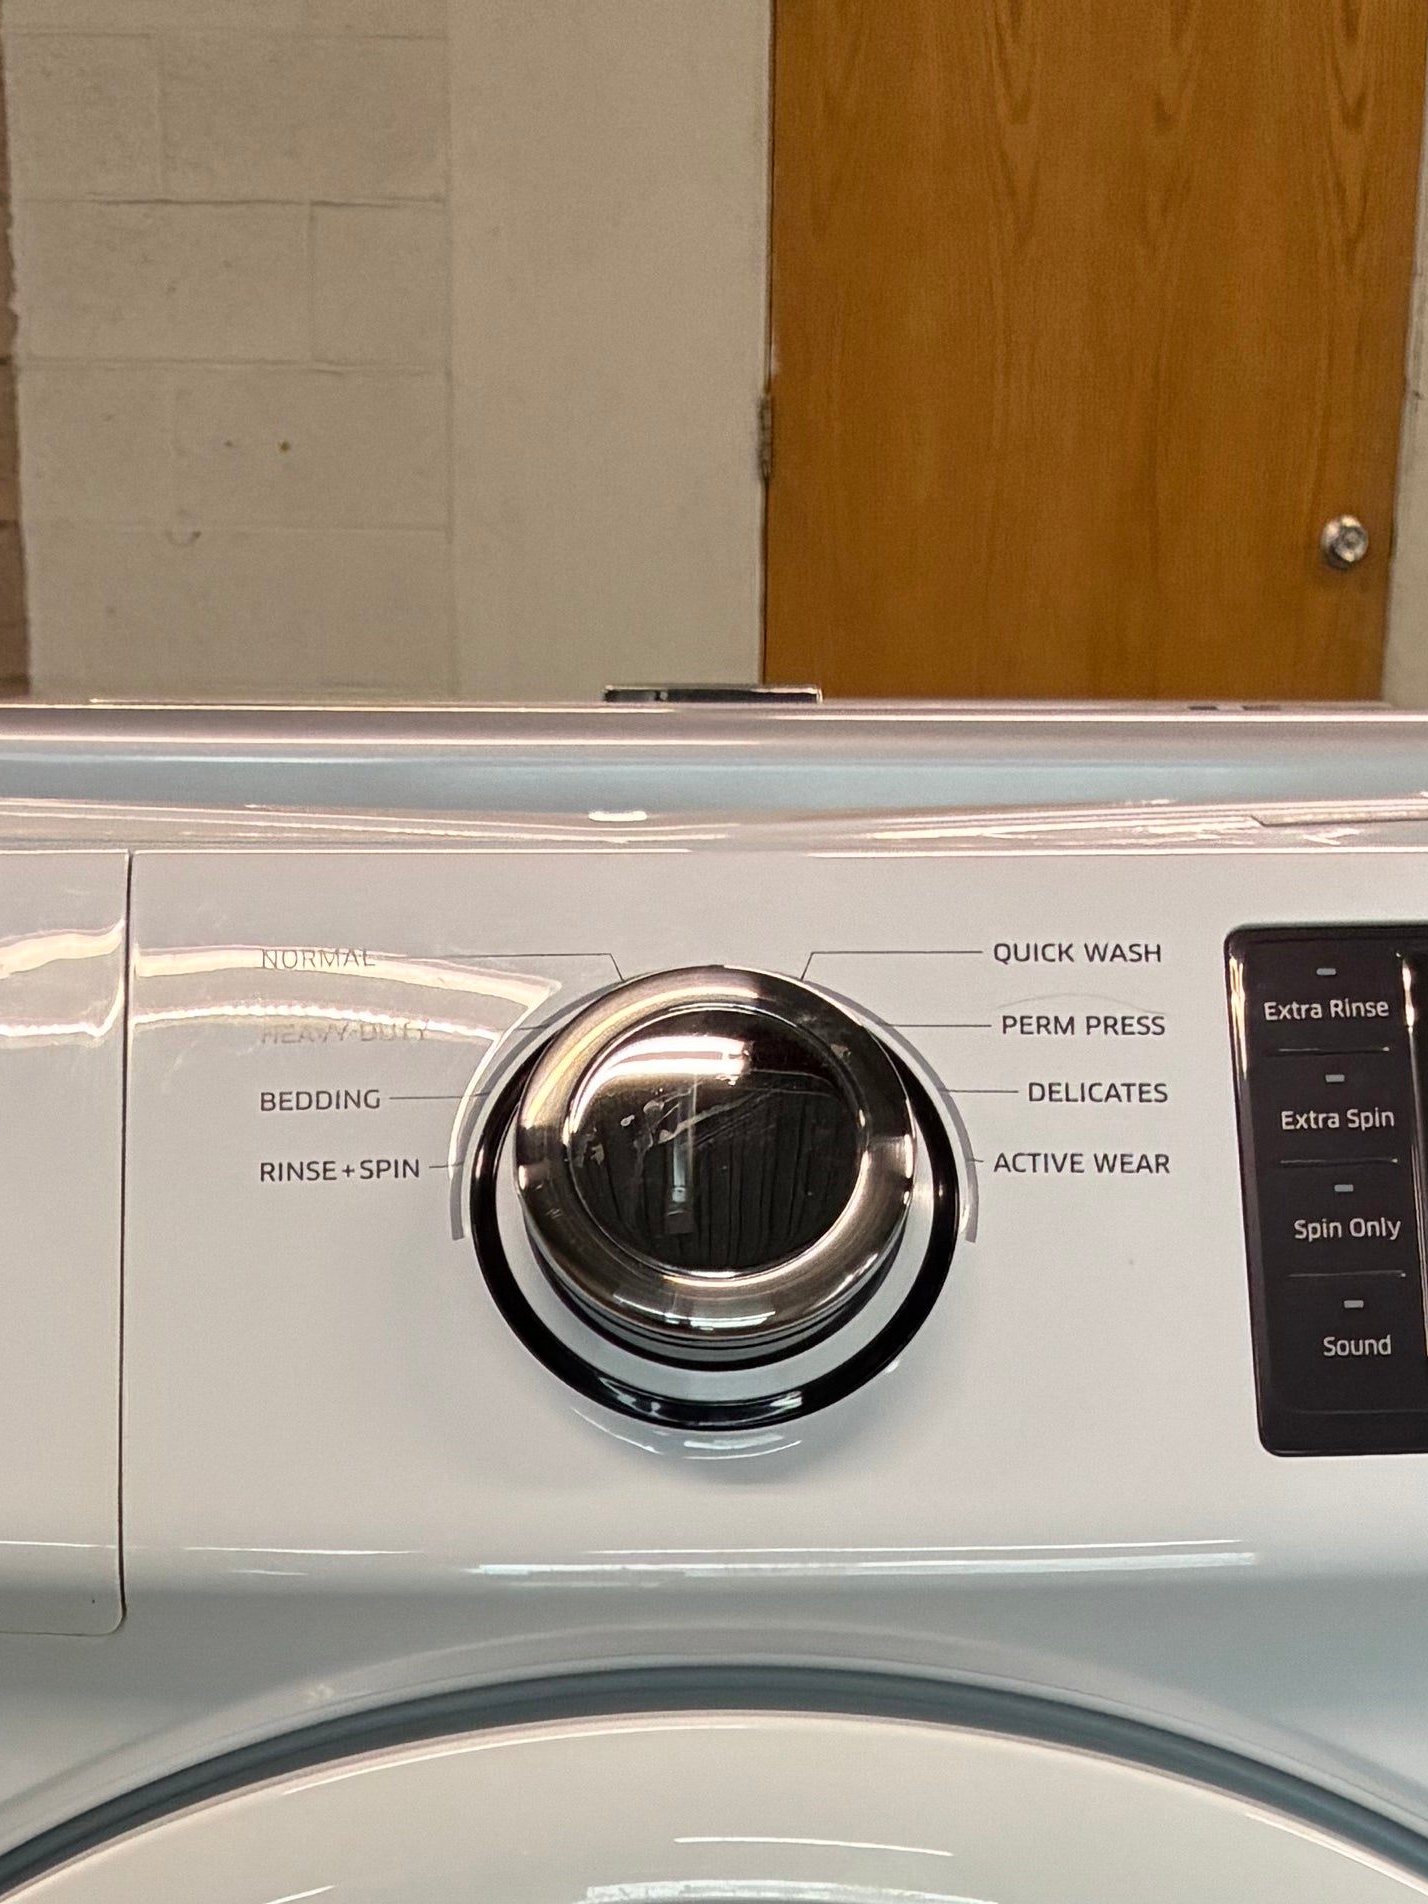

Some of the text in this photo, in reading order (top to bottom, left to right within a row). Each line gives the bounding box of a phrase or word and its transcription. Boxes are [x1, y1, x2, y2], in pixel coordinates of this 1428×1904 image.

[261, 948, 376, 969] NORMAL
[993, 942, 1162, 966] QUICK WASH
[1264, 998, 1390, 1022] Extra Rinse
[1002, 1015, 1166, 1037] PERM PRESS
[260, 1089, 381, 1112] BEDDING
[1028, 1081, 1169, 1104] DELICATES
[1280, 1106, 1395, 1132] Extra Spin
[993, 1152, 1171, 1175] ACTIVE WEAR
[1294, 1215, 1402, 1243] Spin Only
[1322, 1334, 1393, 1358] Sound
